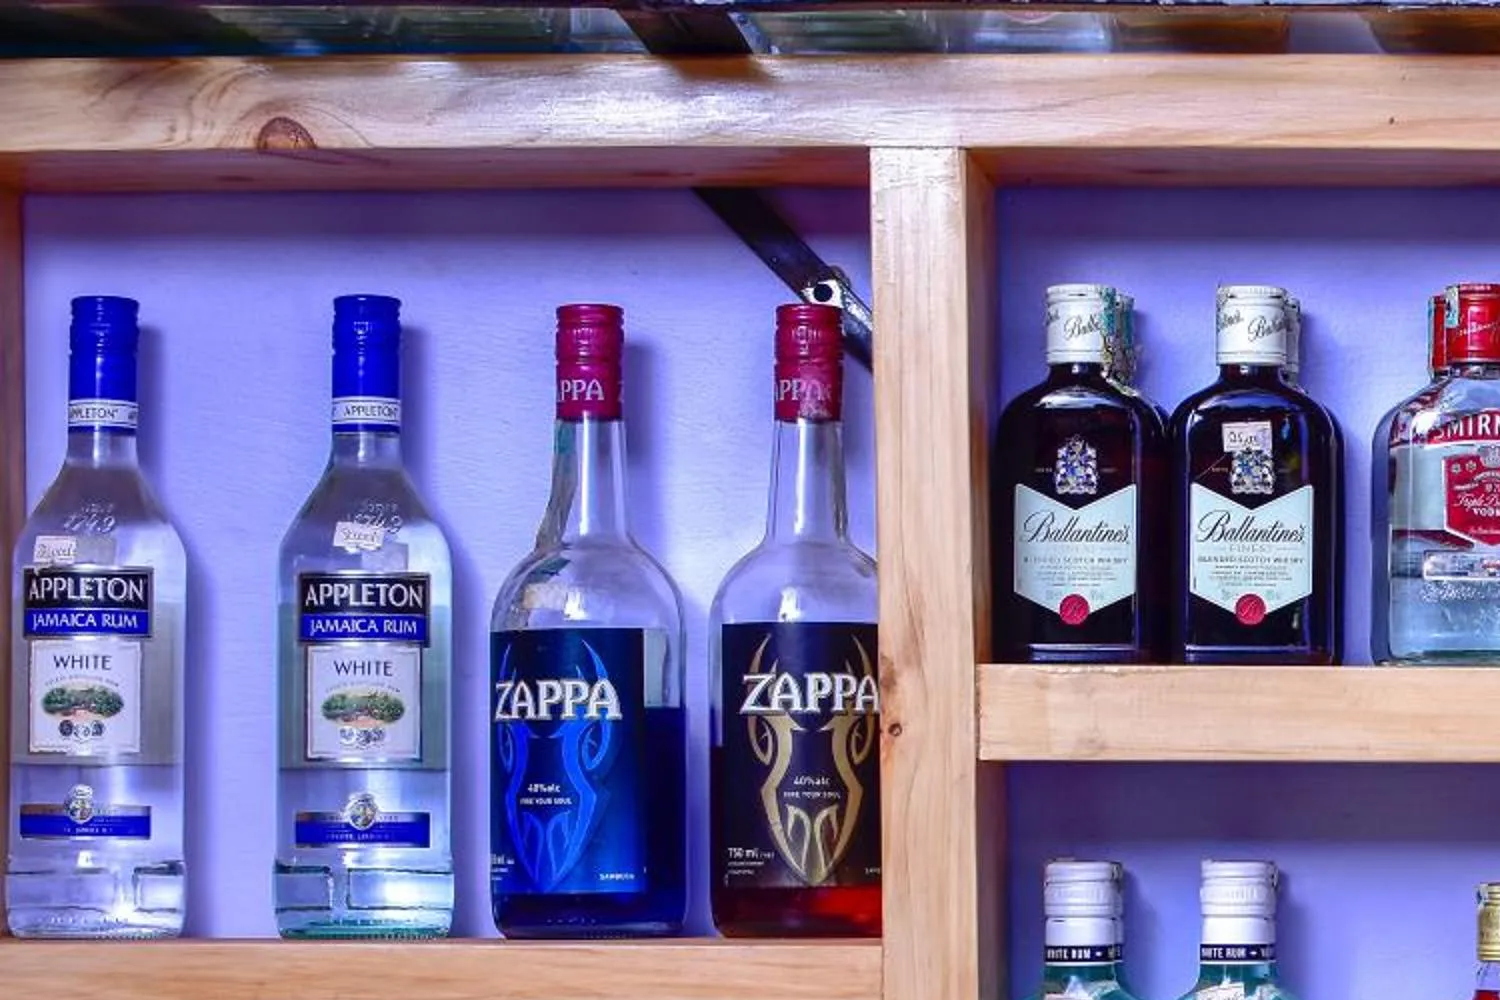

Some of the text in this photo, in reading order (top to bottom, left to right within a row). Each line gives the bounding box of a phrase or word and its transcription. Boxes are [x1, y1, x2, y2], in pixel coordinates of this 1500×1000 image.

[1023, 509, 1132, 544] Ballantine's
[1196, 509, 1306, 544] Ballantine's
[29, 577, 146, 602] APPLETON
[305, 584, 424, 609] APPLETON
[32, 613, 138, 630] JAMAICA RUM
[309, 618, 418, 635] JAMAICA RUM
[53, 654, 112, 671] WHITE
[333, 660, 393, 677] WHITE
[495, 678, 623, 721] ZAPPA
[739, 671, 881, 715] ZAPPA
